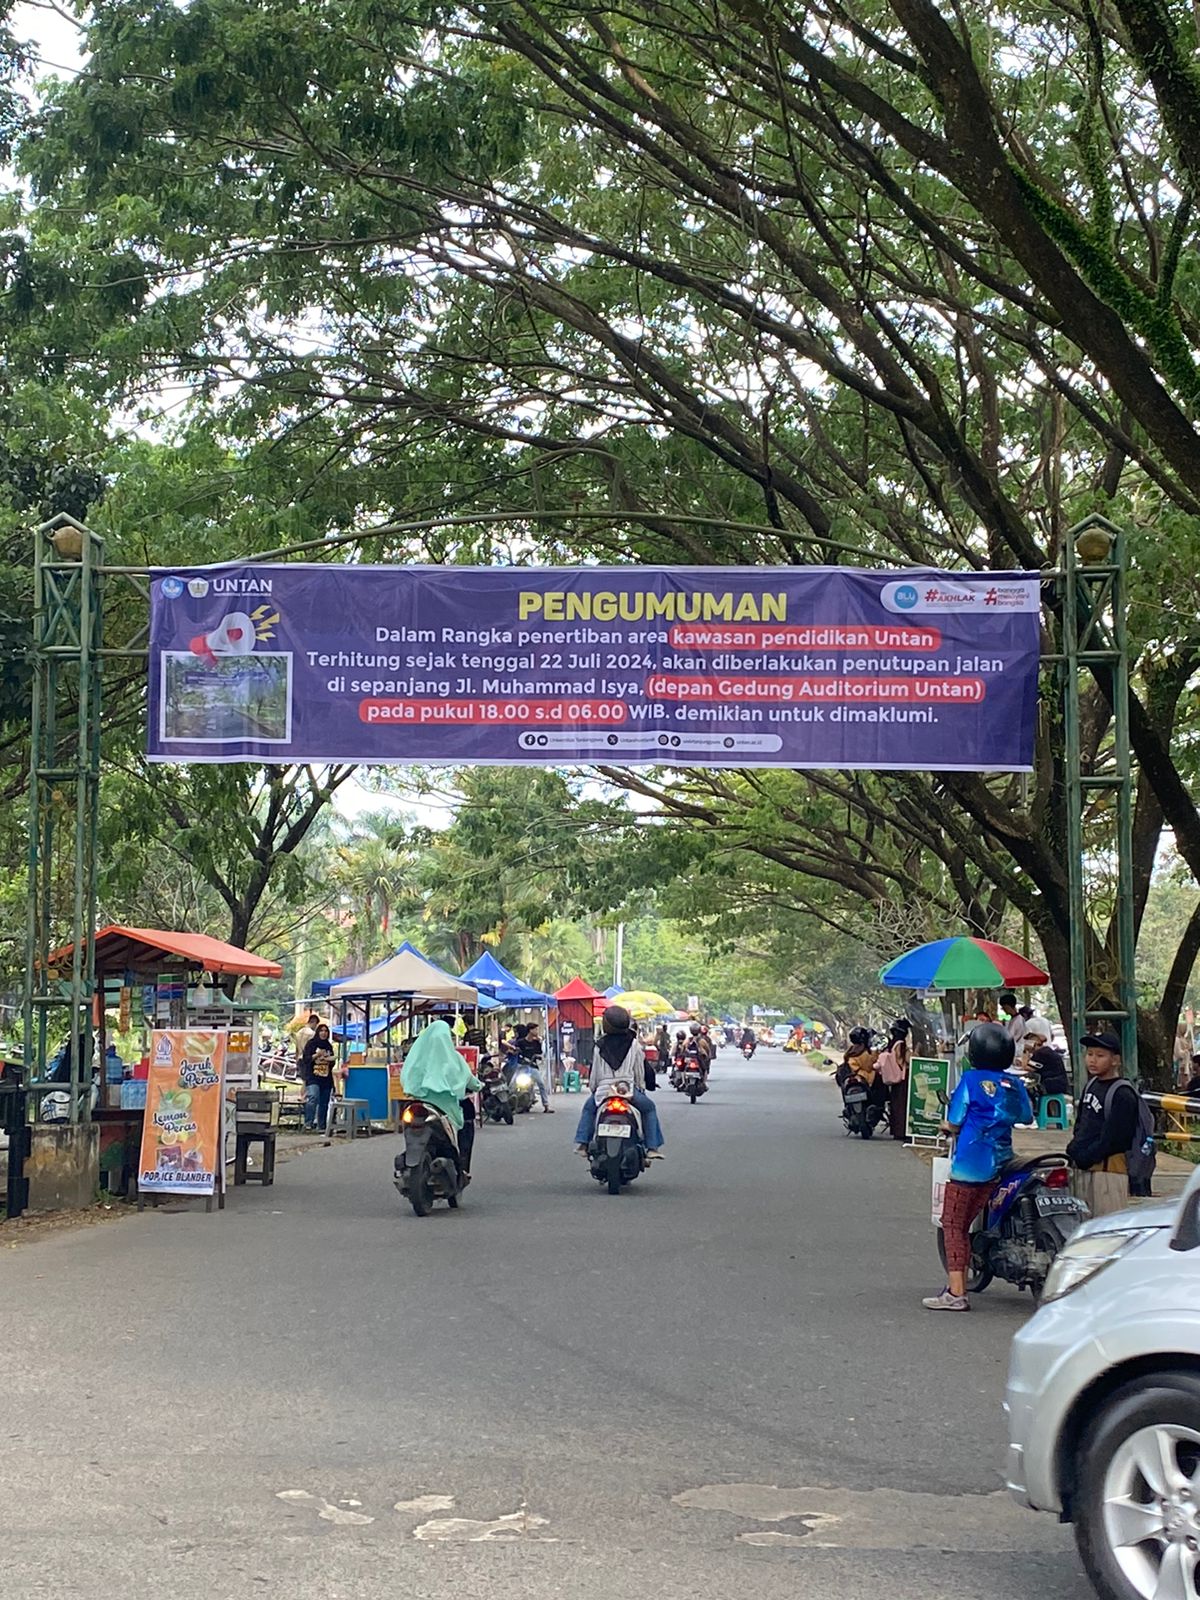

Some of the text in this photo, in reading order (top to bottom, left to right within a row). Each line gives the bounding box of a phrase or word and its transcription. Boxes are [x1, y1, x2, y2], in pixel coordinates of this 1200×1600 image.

[213, 578, 273, 592] UNTAN
[518, 591, 788, 622] PENGUMUMAN
[376, 627, 933, 649] Dalam Rangka penertiban area kawasan pendidikan Untan
[307, 651, 1004, 676] Terhitung sejak tenggal 22 Juli 2024, akan diberlakukan penutupan jalan
[327, 676, 982, 700] di sepanjang Jl. Muhammad Isya, (depan Gedung Auditorium Untan)
[367, 702, 939, 723] pada pukul 18.00 s.d 06.00 WIB. demikian untuk dimaklumi.
[180, 1057, 213, 1076] Jeruk
[185, 1072, 220, 1089] Peras
[153, 1112, 188, 1126] Lemon
[164, 1121, 197, 1134] Peras
[175, 1172, 212, 1183] BLANDER
